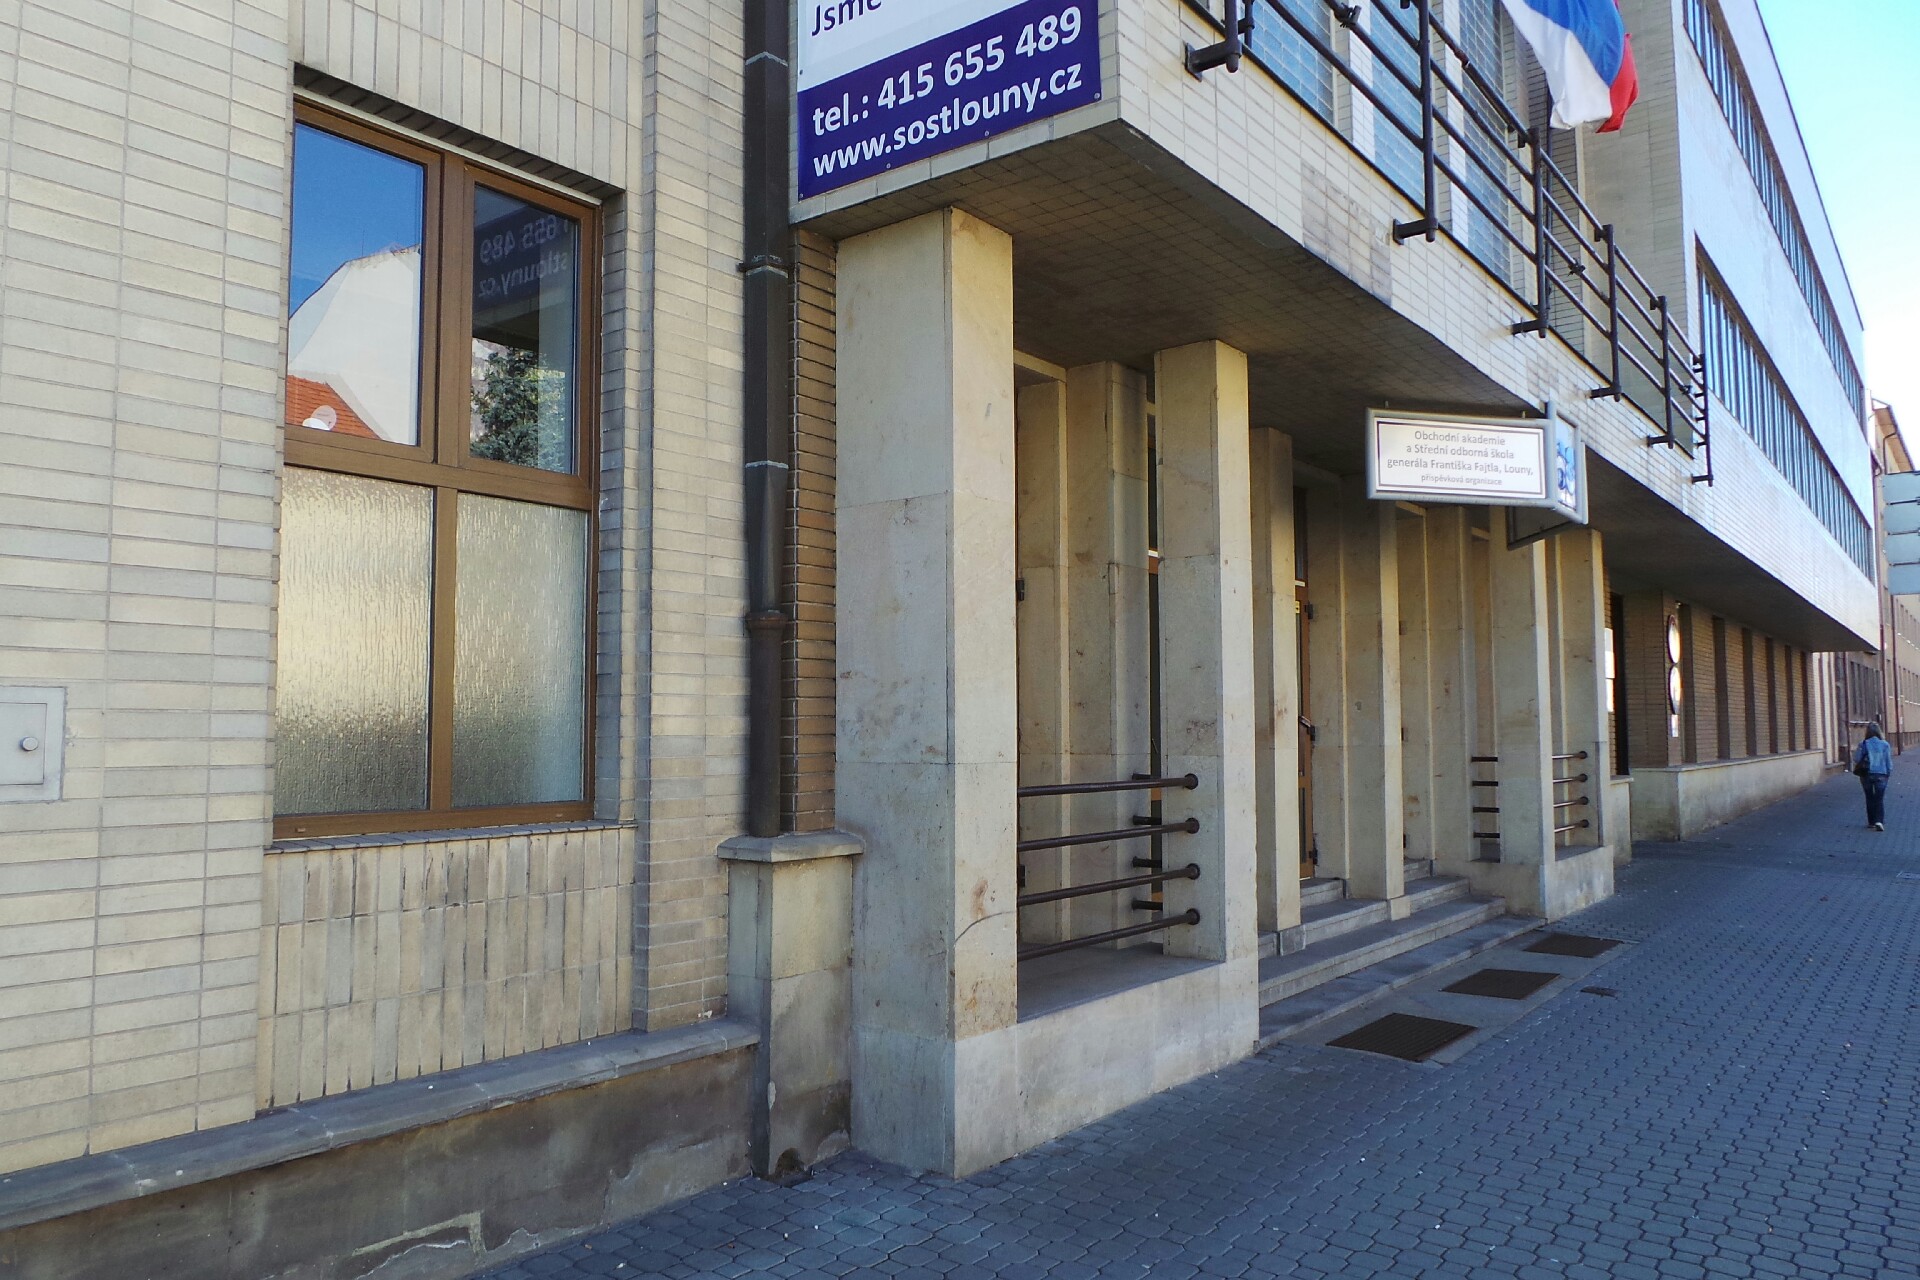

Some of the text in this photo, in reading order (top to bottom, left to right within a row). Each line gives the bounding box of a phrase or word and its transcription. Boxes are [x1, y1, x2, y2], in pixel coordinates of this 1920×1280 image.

[813, 7, 1082, 136] tel.: 415 655 489
[813, 63, 1082, 177] www.sostlouny.cz
[1414, 430, 1505, 445] Obchodní akademie
[1406, 444, 1514, 459] a Střední odborná škola
[1387, 458, 1534, 476] generála Františka Fajtla, Louny,
[1465, 476, 1502, 486] organizace
